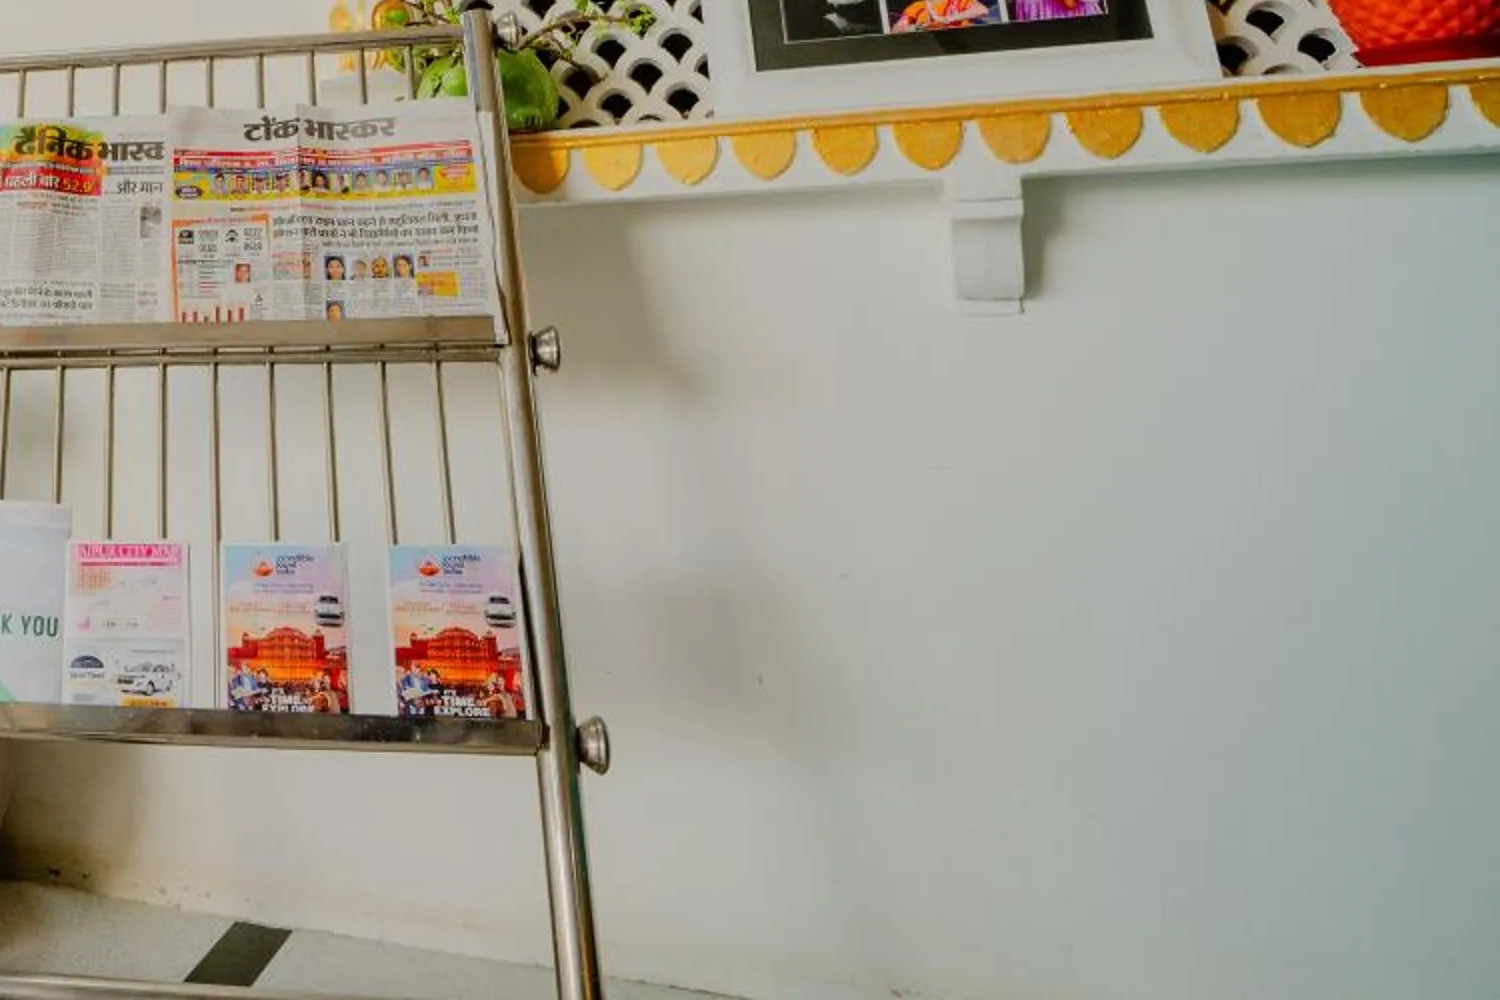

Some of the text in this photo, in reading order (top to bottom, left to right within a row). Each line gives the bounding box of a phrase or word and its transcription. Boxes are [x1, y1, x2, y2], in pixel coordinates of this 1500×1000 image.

[243, 115, 397, 141] टोंक भास्कर
[14, 124, 93, 160] दैनिक
[21, 615, 58, 637] YOU
[442, 696, 476, 707] TIME
